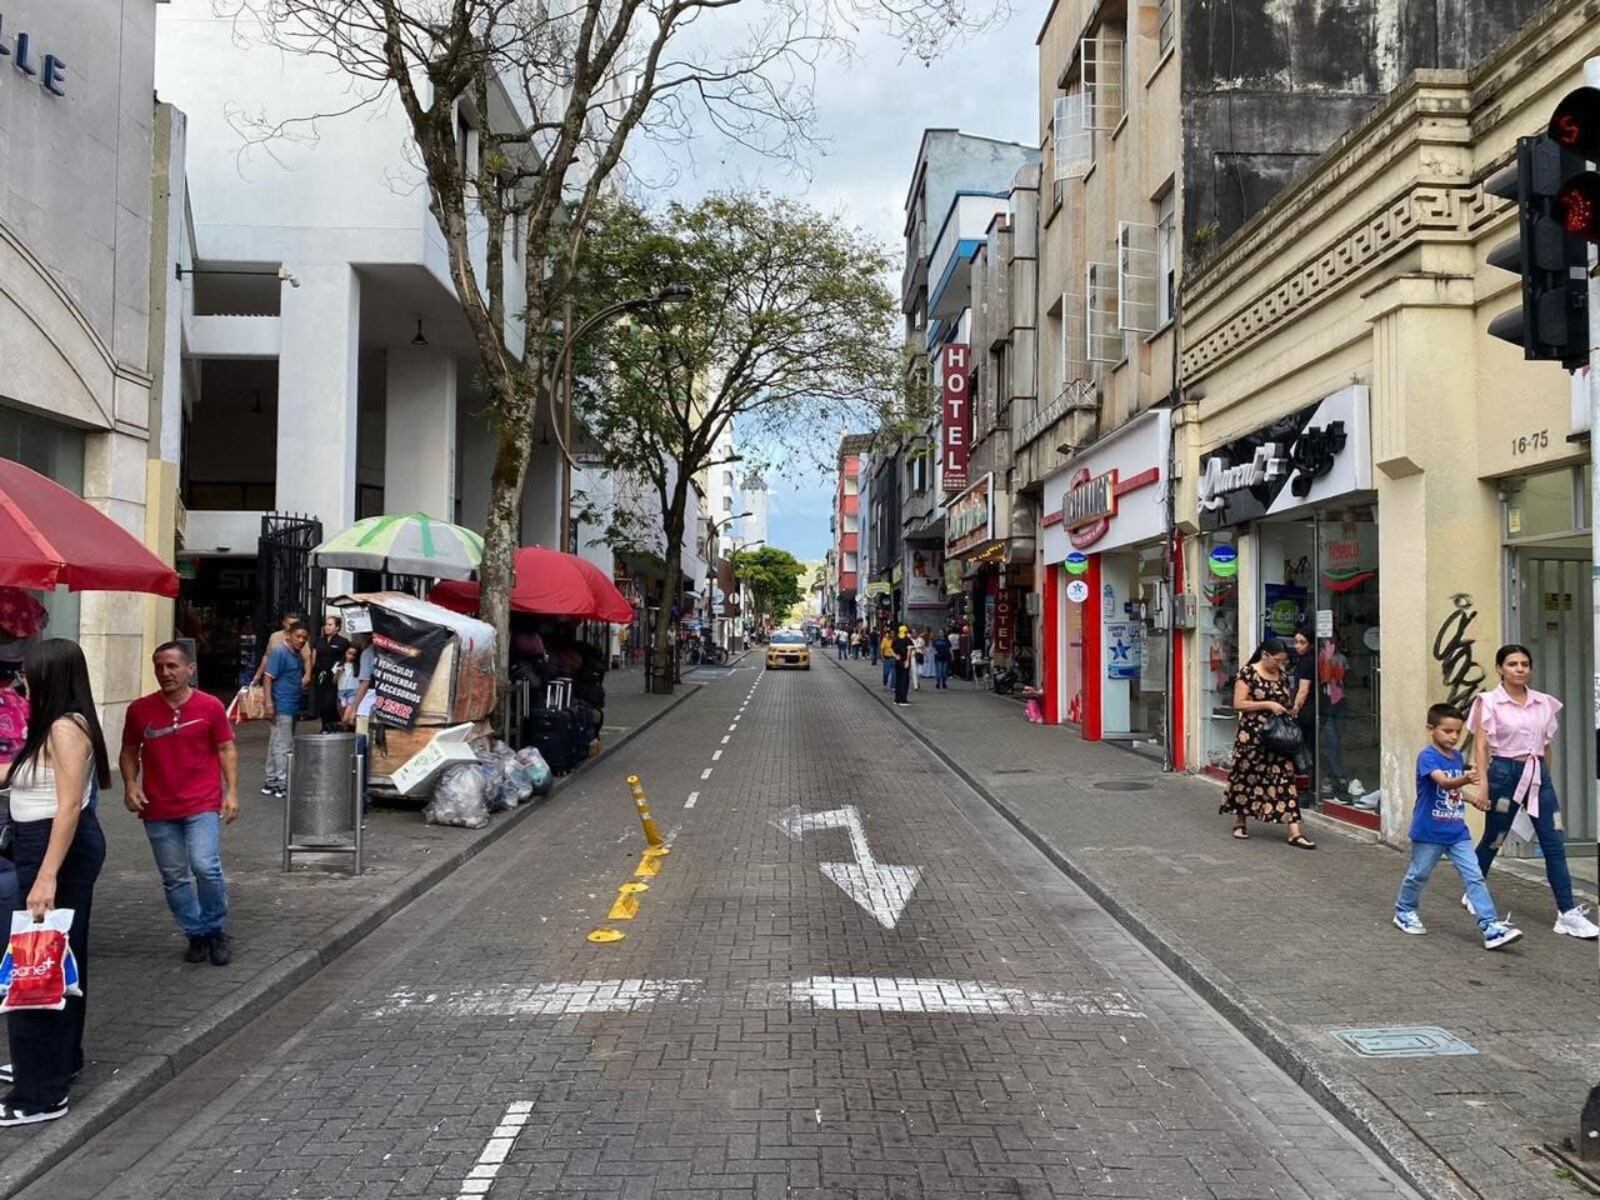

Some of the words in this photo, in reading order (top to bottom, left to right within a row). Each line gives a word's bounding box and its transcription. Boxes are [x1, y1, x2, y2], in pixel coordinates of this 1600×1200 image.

[948, 348, 965, 471] HOTEL
[1511, 430, 1549, 455] 16-75
[998, 592, 1009, 650] HOTEL
[378, 683, 421, 703] ACCESORIOS
